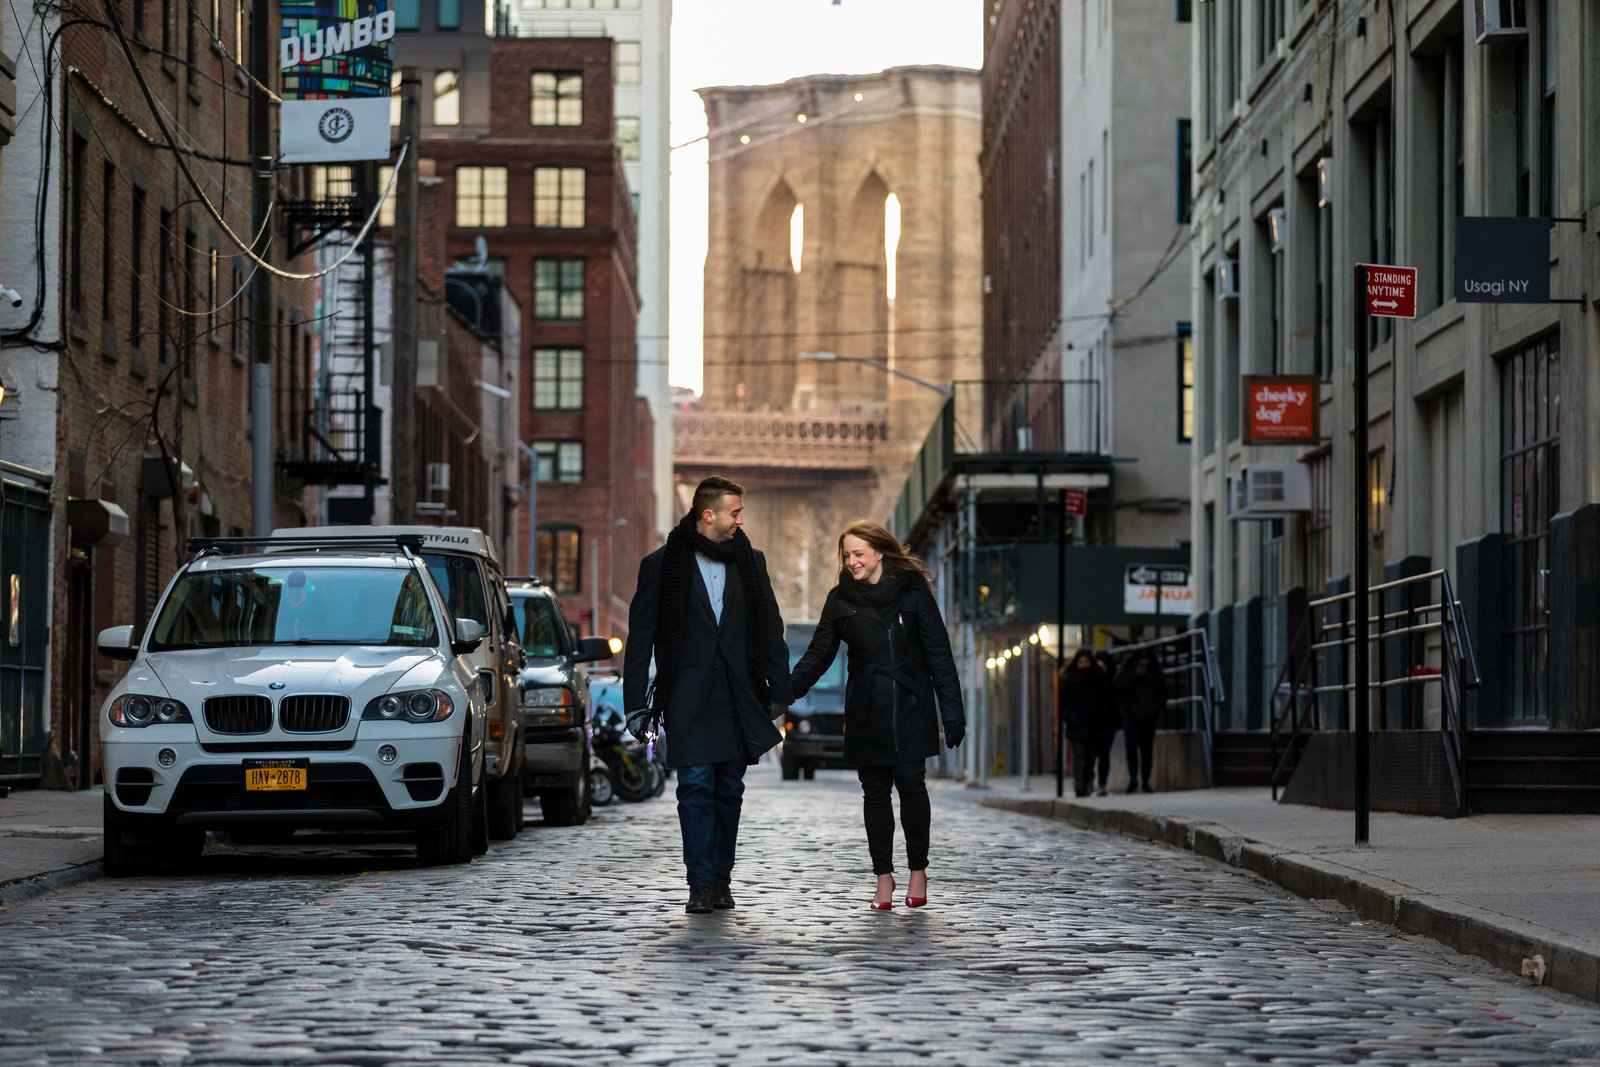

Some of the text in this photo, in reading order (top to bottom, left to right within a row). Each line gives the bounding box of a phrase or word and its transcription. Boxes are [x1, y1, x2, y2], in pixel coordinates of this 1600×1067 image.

[281, 10, 395, 69] DUMBO
[1374, 272, 1411, 285] STANDING
[1464, 279, 1529, 296] Usagi NY
[1367, 285, 1405, 298] ANYTIME
[1255, 386, 1307, 406] cheeky
[1255, 404, 1282, 424] dog
